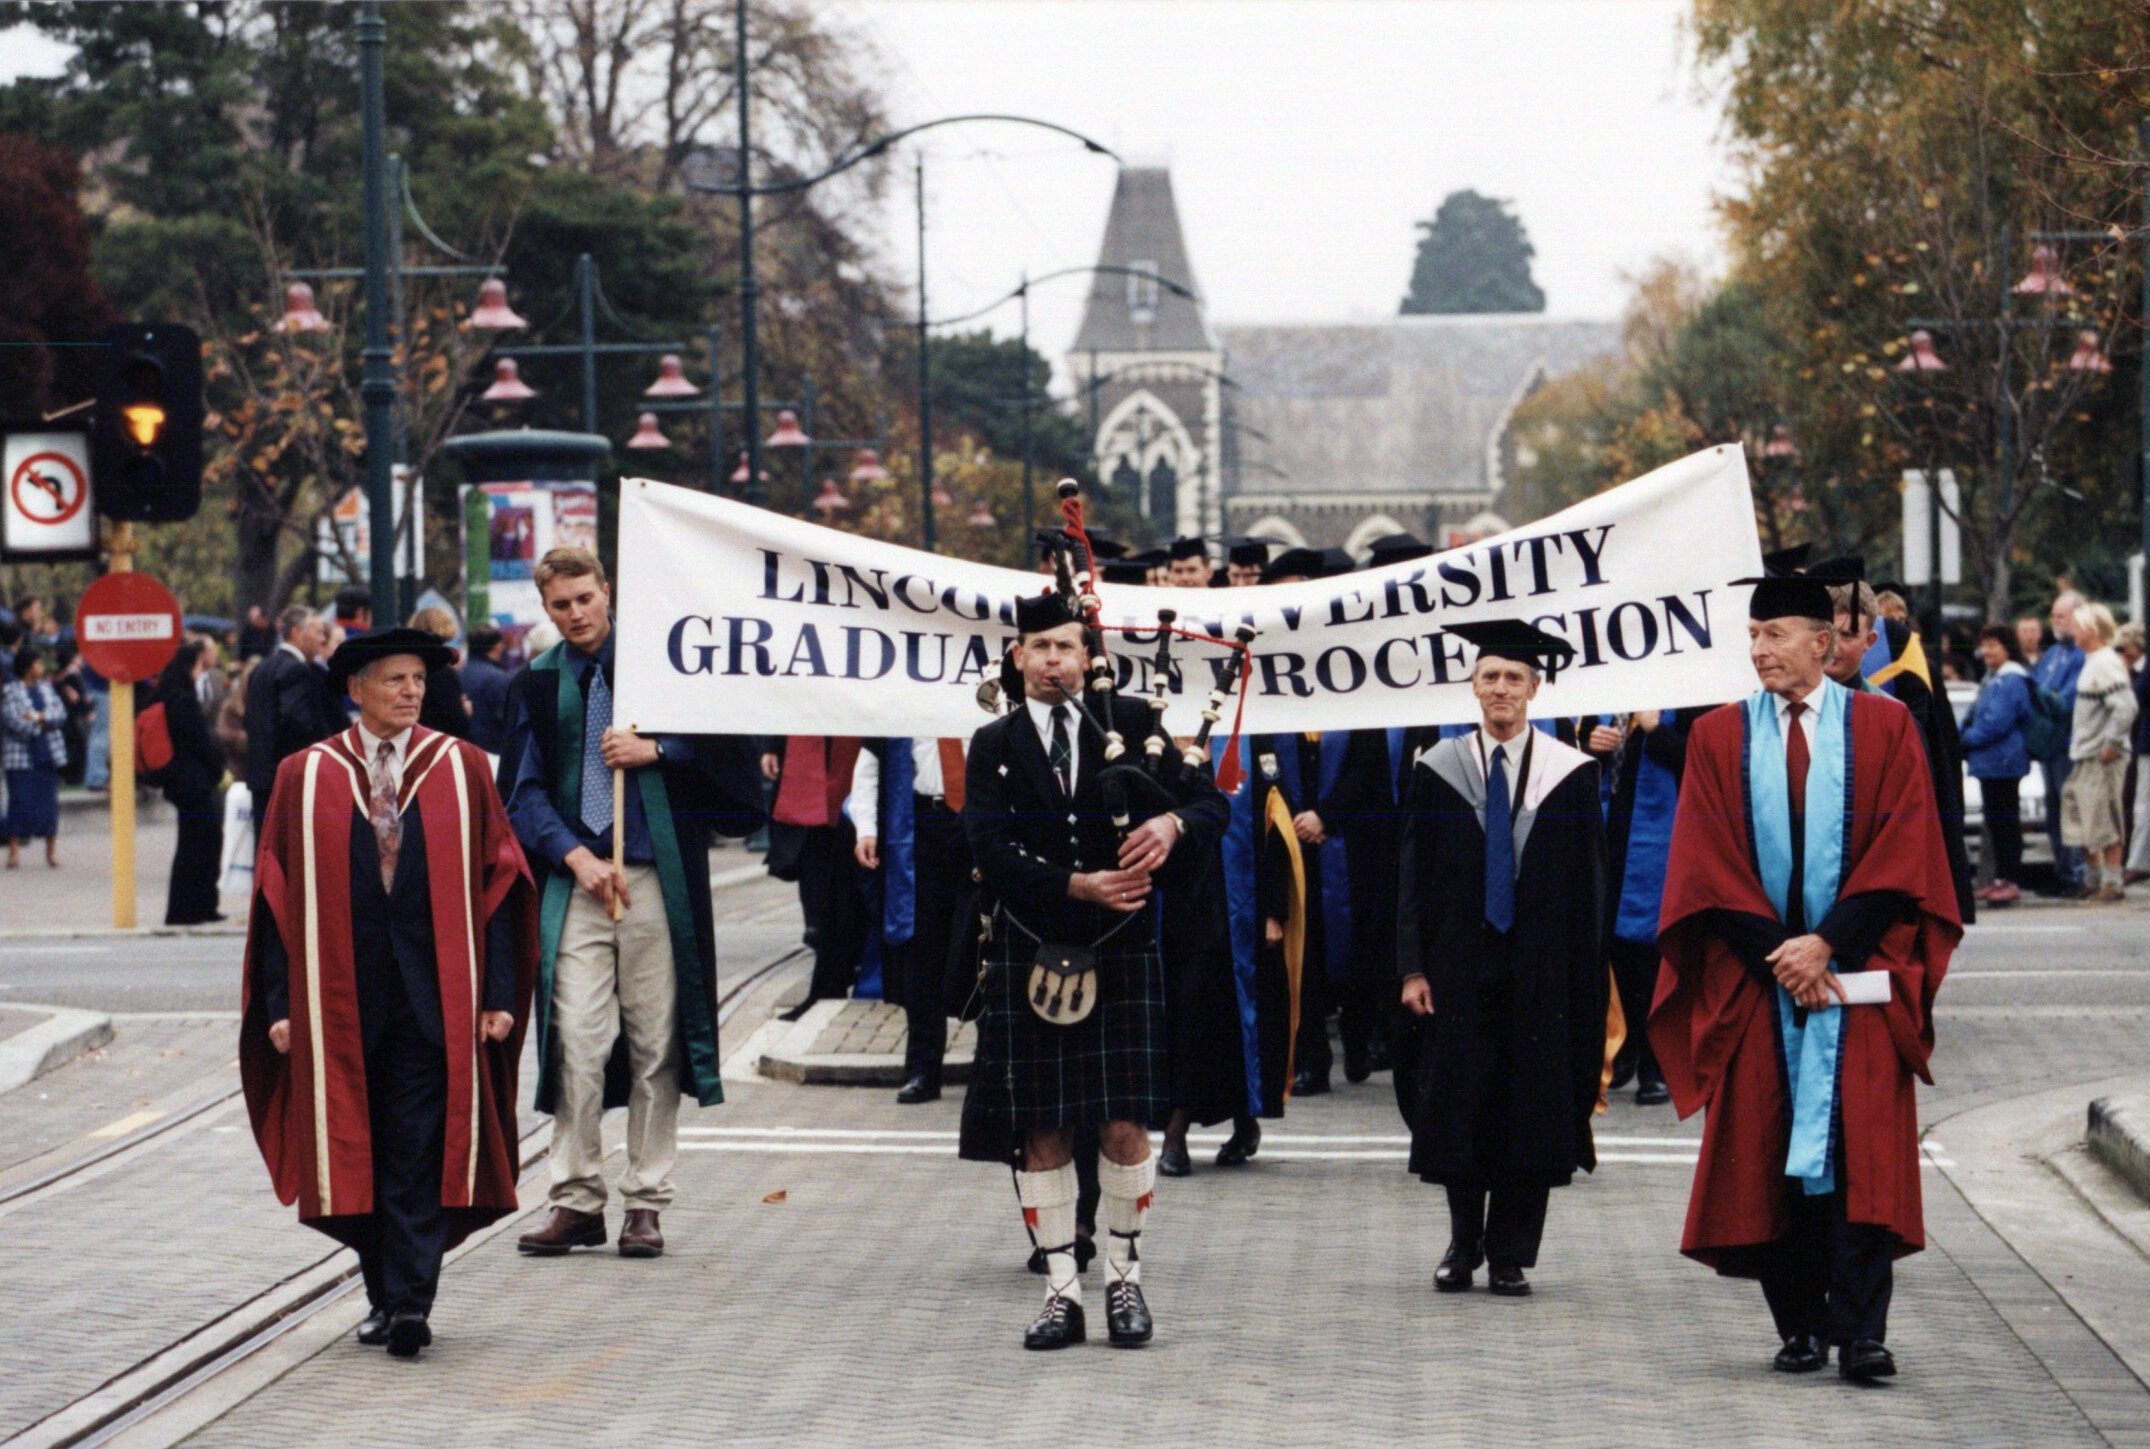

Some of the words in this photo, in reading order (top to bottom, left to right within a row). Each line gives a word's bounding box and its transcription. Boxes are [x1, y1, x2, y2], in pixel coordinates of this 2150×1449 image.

[95, 620, 112, 635] NO
[116, 618, 160, 634] ENTRY
[756, 547, 1018, 629] LINCO
[1202, 589, 1714, 698] PROCESION
